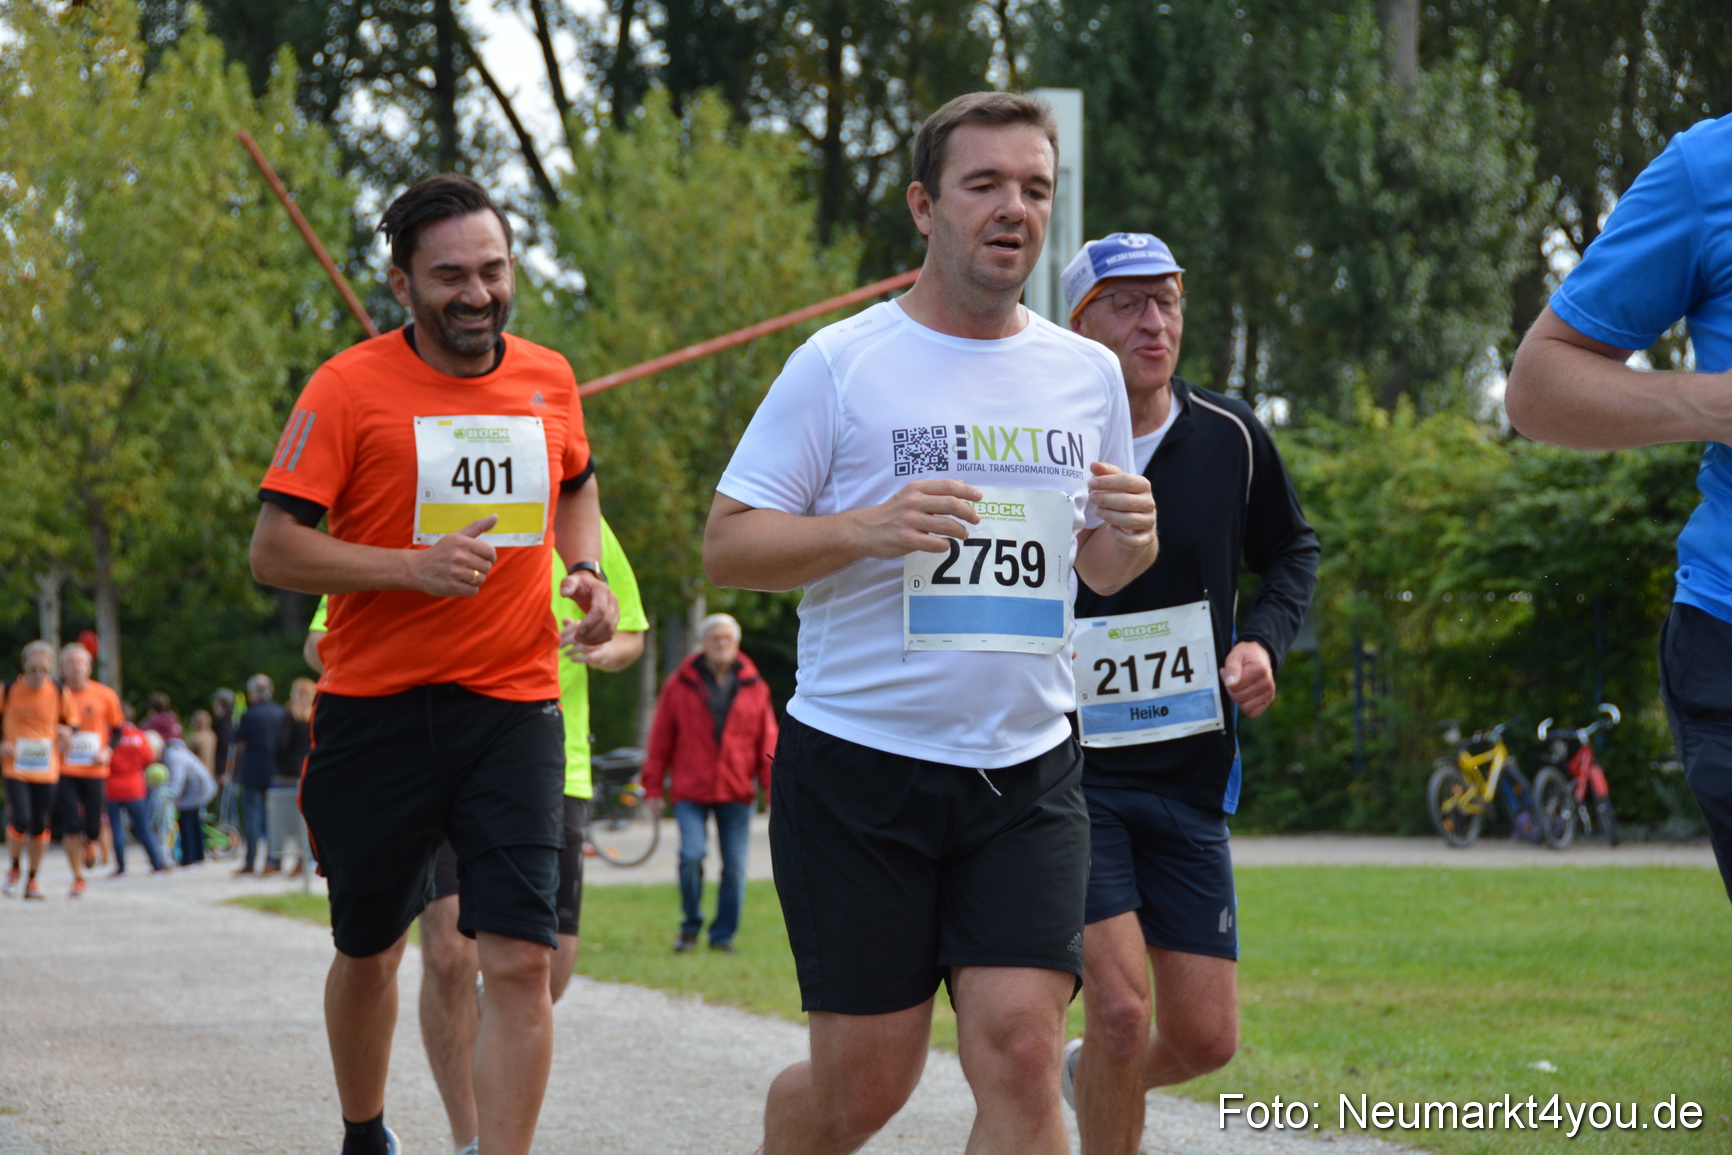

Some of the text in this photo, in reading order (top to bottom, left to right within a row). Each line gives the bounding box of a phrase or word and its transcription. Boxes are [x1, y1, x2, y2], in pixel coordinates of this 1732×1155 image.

[467, 428, 510, 439] BOCK
[972, 425, 1084, 469] NXTGN
[451, 457, 513, 495] 401
[956, 462, 1084, 480] DIGITAL TRANSFORMATION EXPERTS
[973, 501, 1026, 517] BOCK
[931, 537, 1046, 588] 2759
[913, 579, 920, 588] D
[1122, 621, 1170, 639] BOCK
[1093, 646, 1194, 696] 2174
[1130, 705, 1169, 721] Heiko
